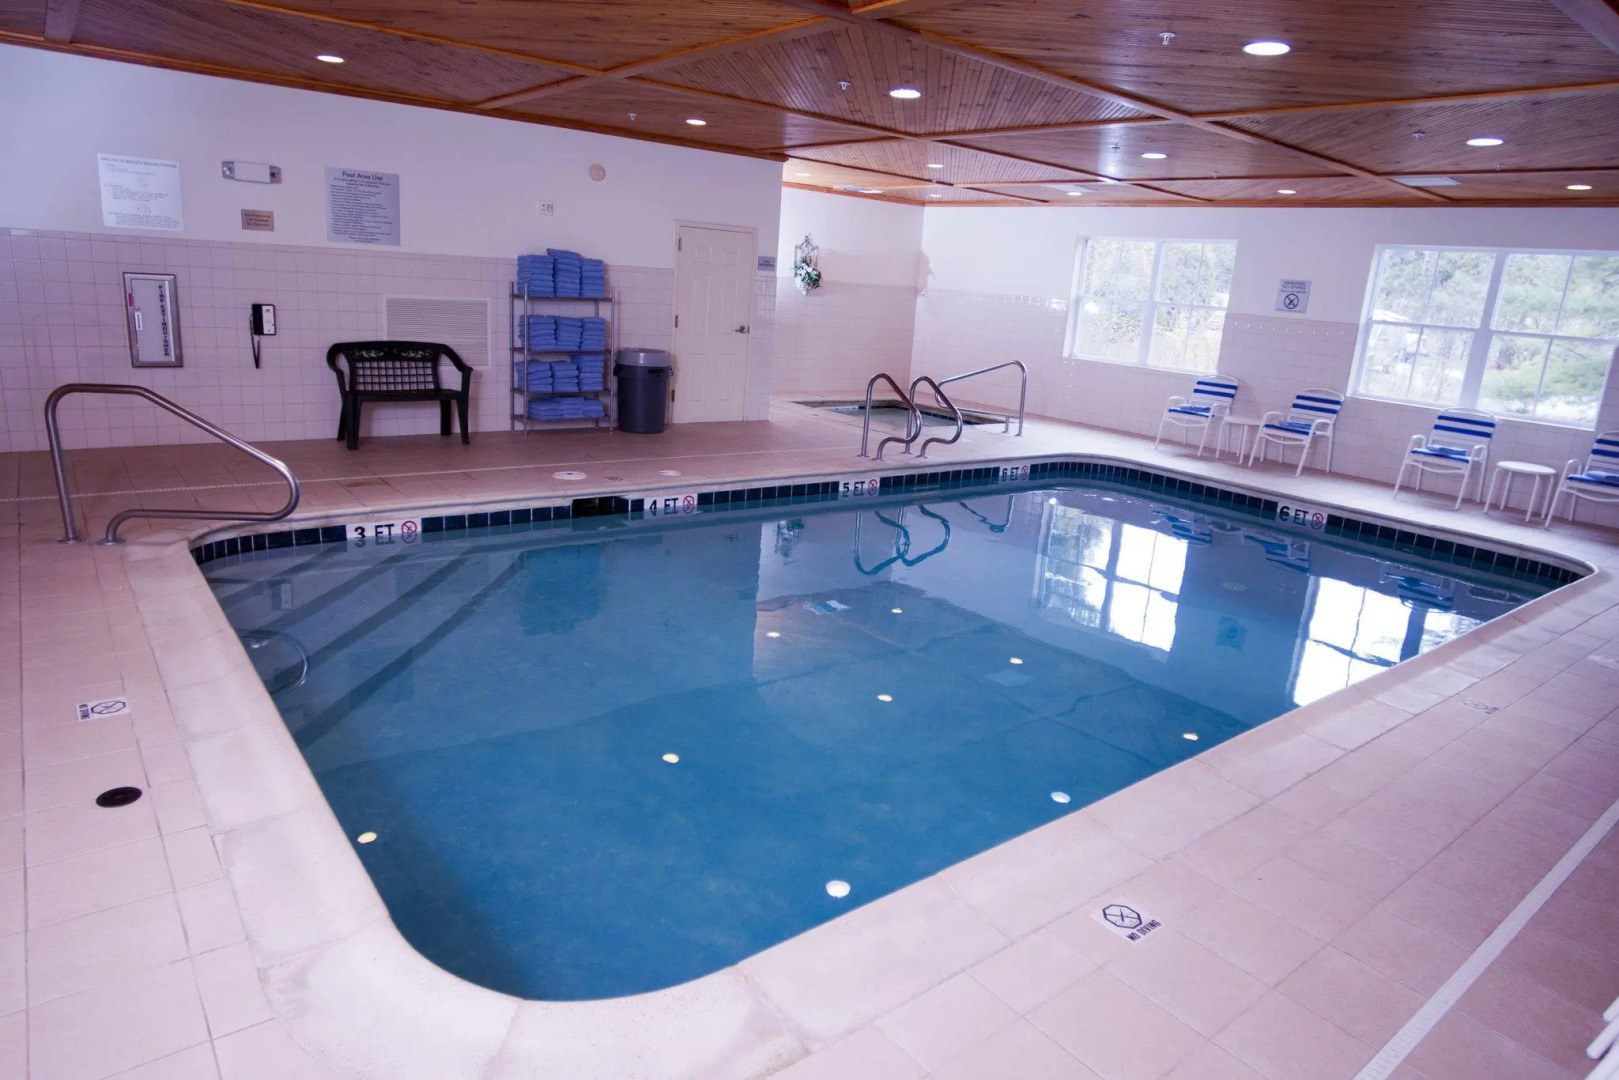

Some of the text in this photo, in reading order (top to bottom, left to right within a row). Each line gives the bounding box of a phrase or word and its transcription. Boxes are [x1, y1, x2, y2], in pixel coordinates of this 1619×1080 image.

[160, 304, 170, 356] EXTINGUISHER
[843, 481, 865, 491] 5 FT
[649, 498, 679, 509] 4 FT
[1279, 505, 1290, 517] 6
[354, 524, 395, 538] 3 FT
[1126, 919, 1162, 942] NO DIVING
